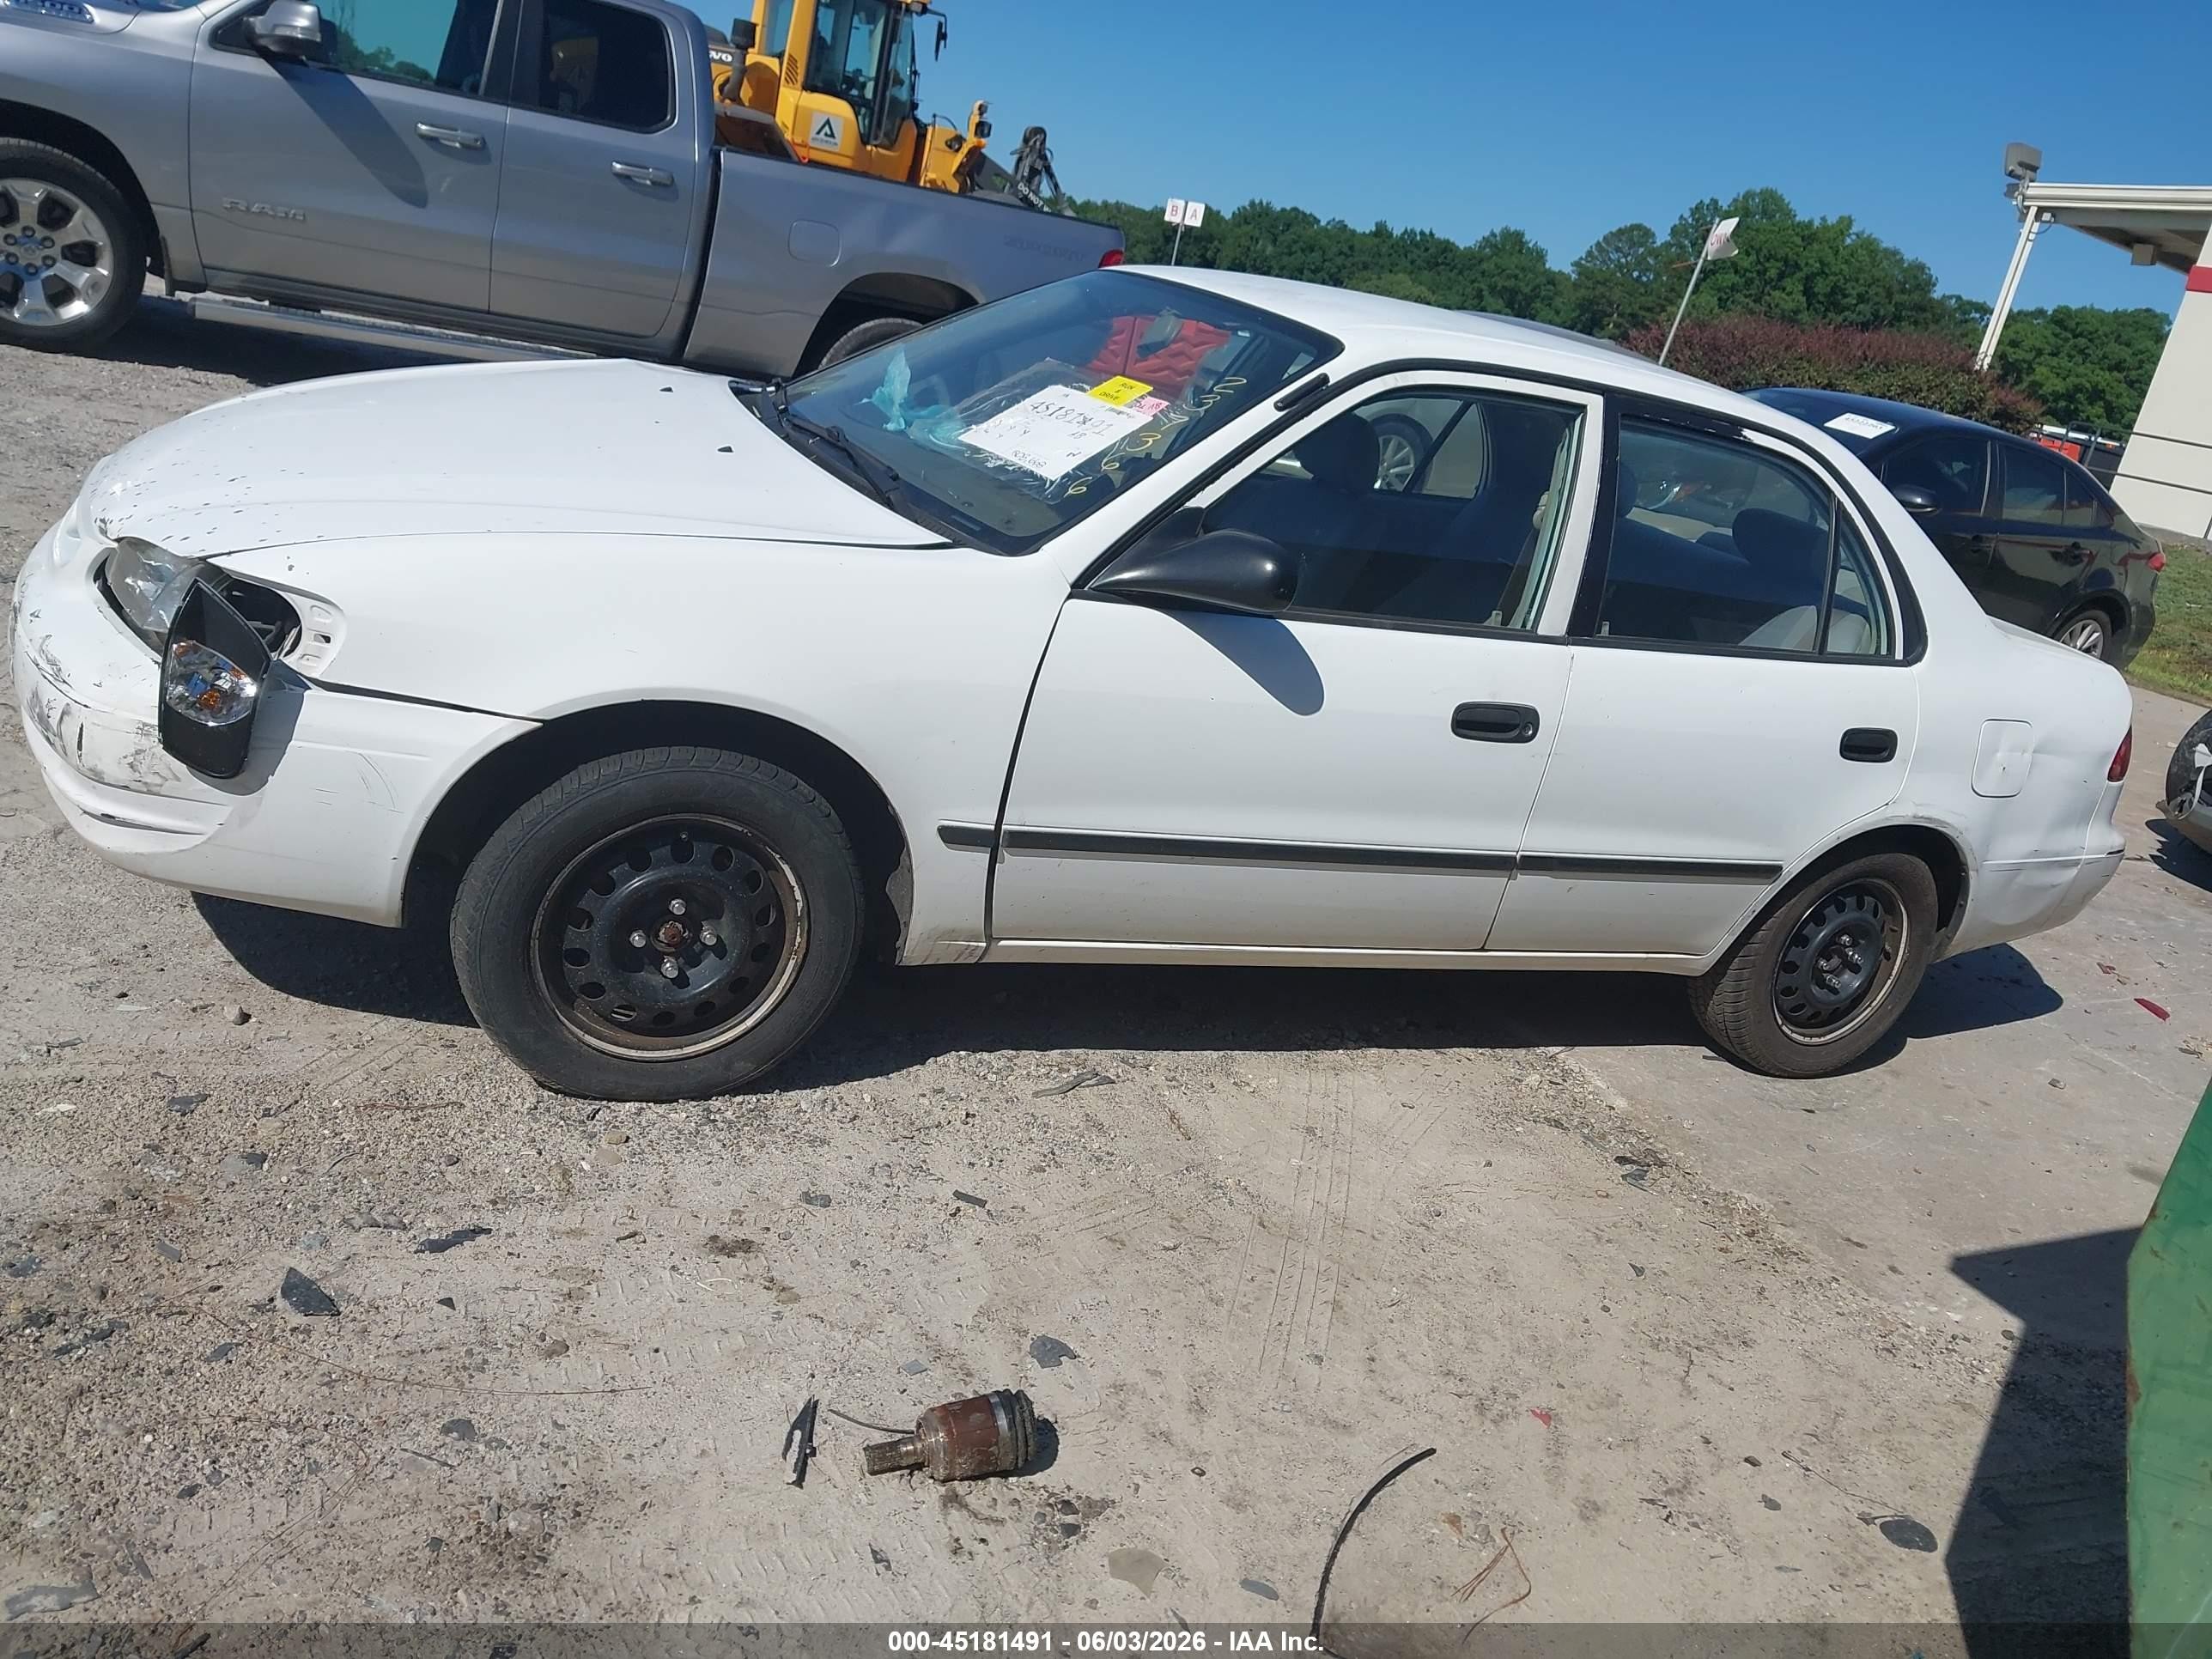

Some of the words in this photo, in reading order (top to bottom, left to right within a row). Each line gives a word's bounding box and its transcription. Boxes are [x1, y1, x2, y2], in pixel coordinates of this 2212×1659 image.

[708, 50, 732, 62] VO
[1018, 182, 1030, 195] DO
[1028, 191, 1044, 208] NOT
[223, 198, 307, 220] RAM
[1170, 205, 1178, 217] B
[1190, 208, 1198, 220] A
